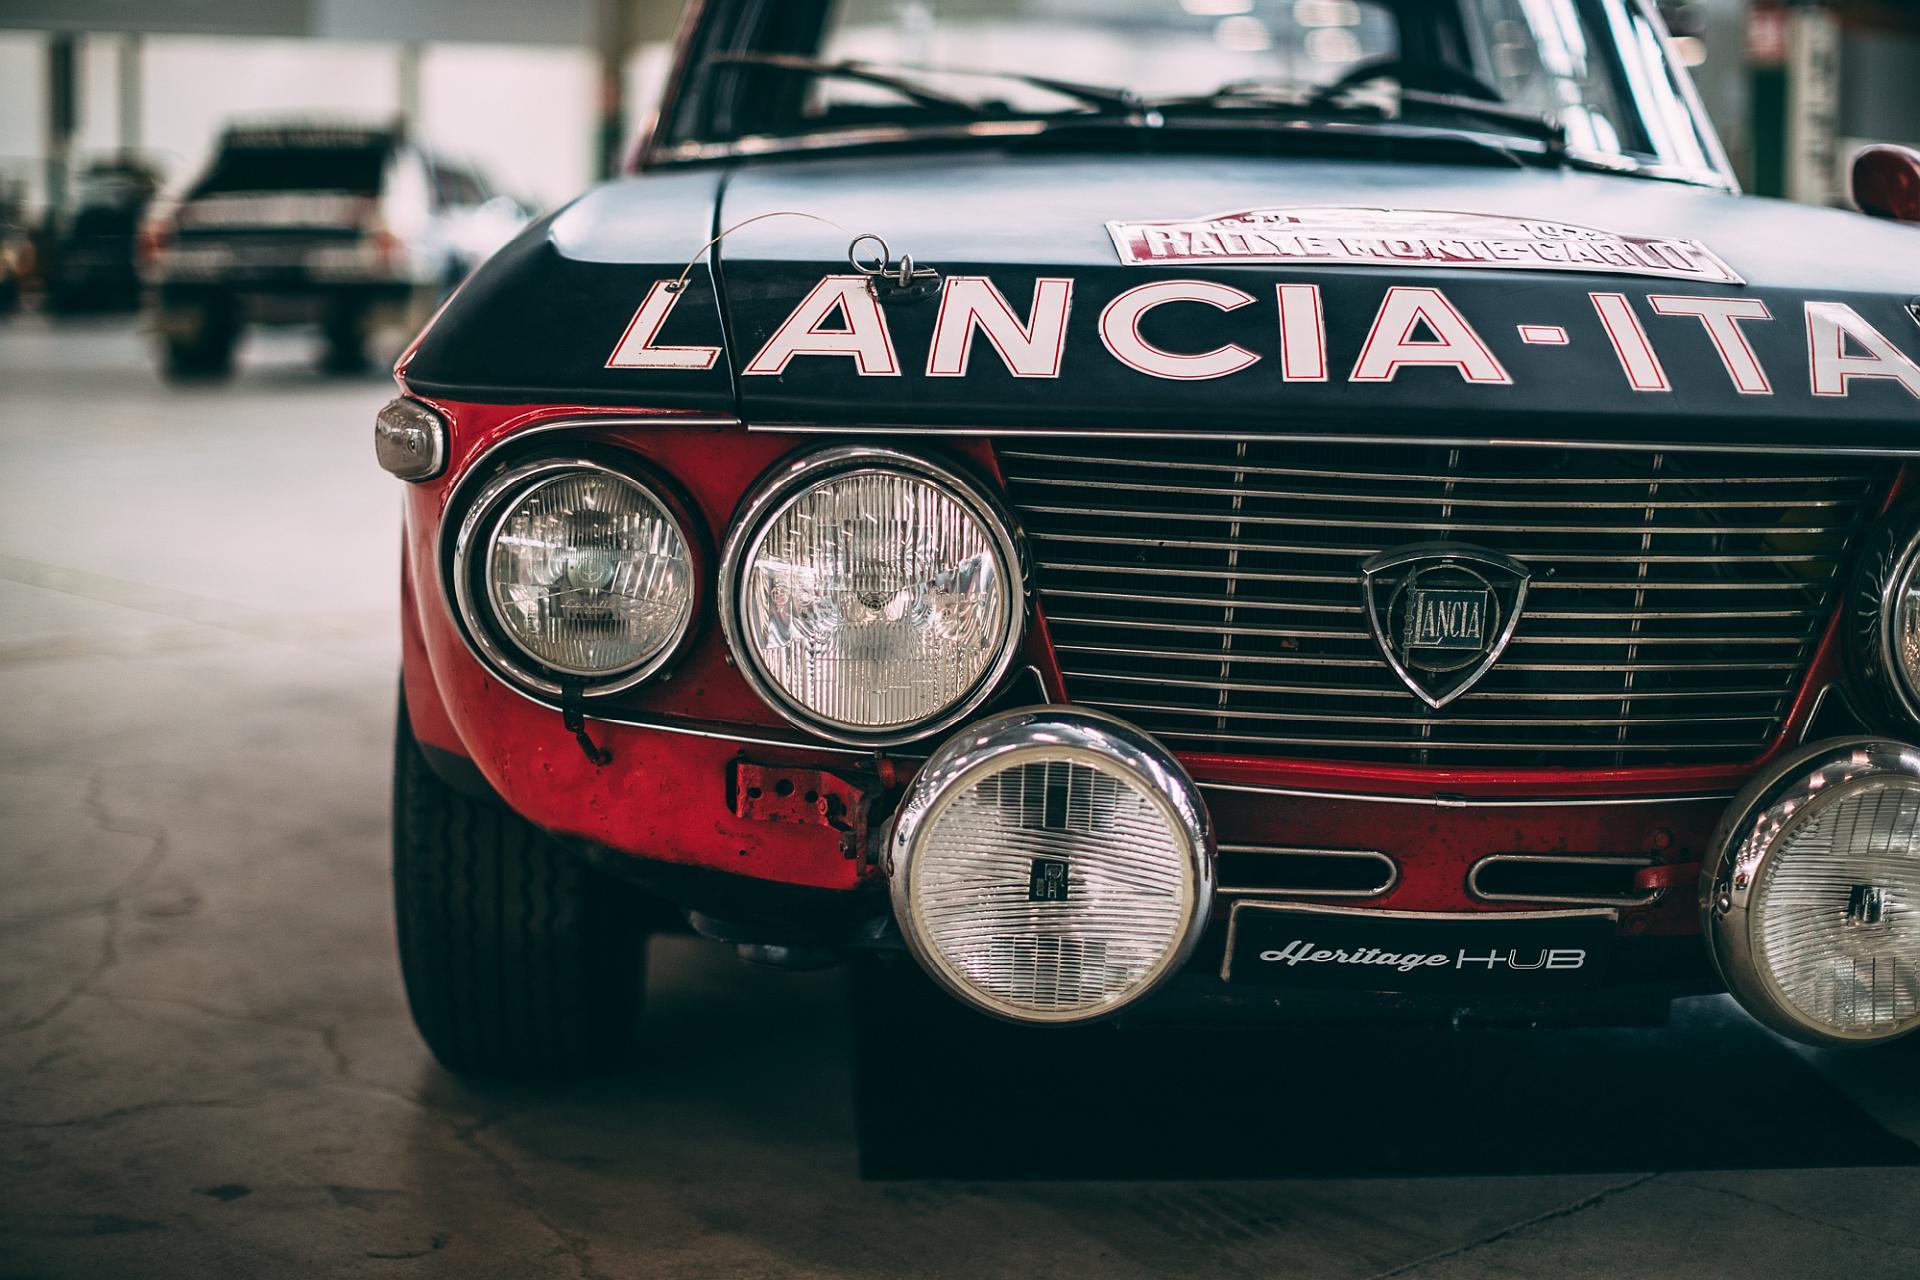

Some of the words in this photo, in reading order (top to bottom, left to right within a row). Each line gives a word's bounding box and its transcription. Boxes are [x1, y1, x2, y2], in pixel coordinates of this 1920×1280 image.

[1143, 229, 1331, 257] RALLYE
[1338, 236, 1703, 272] MONTE-CARLO
[1412, 592, 1481, 646] LANCIA
[1259, 940, 1450, 972] Heritage
[1456, 948, 1587, 970] HUB
